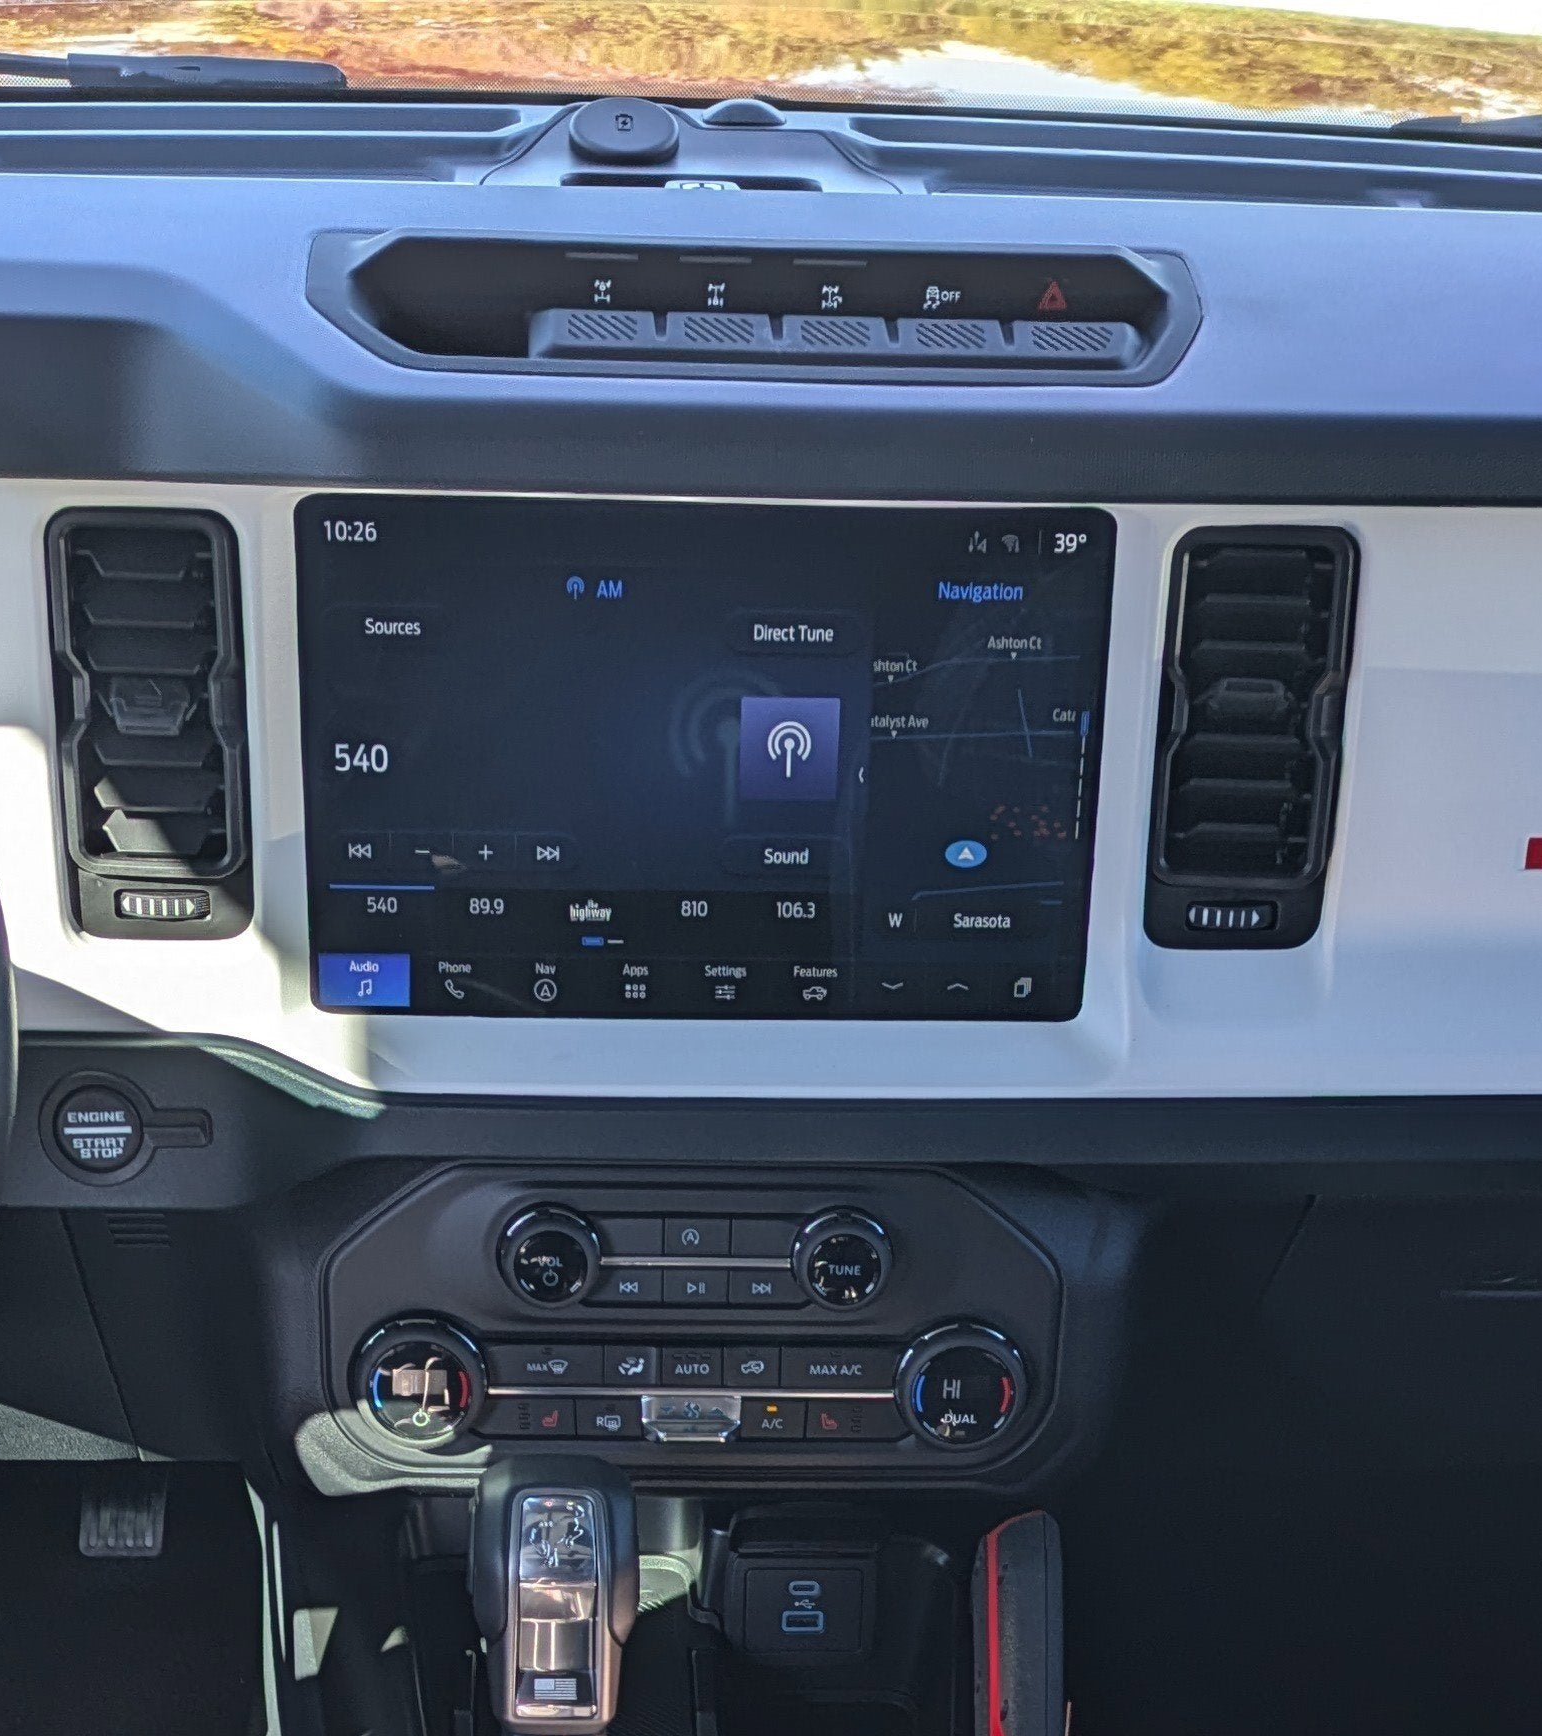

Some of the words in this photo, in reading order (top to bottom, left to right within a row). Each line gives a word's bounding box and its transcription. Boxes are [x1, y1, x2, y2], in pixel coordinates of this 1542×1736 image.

[941, 291, 961, 303] OFF
[323, 520, 377, 542] 10:26
[1054, 533, 1087, 554] 39°
[596, 580, 623, 598] AM
[938, 581, 1024, 603] Navigation
[364, 618, 421, 636] Sources
[754, 624, 795, 642] Direct
[798, 624, 834, 643] Tune
[988, 635, 1027, 650] Ashton
[1029, 636, 1042, 650] Ct
[905, 659, 918, 673] Ct
[908, 715, 929, 729] Ave
[334, 743, 389, 773] 540
[764, 847, 809, 866] Sound
[366, 897, 398, 914] 540
[469, 898, 504, 915] 89.9
[569, 903, 612, 922] highway
[681, 901, 708, 917] 810
[776, 902, 816, 919] 106.3
[888, 913, 903, 928] W
[953, 913, 1011, 929] Sarasota
[349, 961, 380, 974] Audio
[438, 961, 472, 974] Phone
[535, 962, 556, 975] Nav
[623, 963, 649, 978] Apps
[704, 964, 747, 979] Settings
[793, 964, 838, 979] Features
[67, 1111, 125, 1123] ENGINE
[73, 1137, 127, 1149] START
[80, 1147, 124, 1159] STOP
[538, 1255, 563, 1267] VOL
[828, 1265, 861, 1277] TUNE
[527, 1362, 548, 1373] MAX
[675, 1363, 710, 1375] AUTO
[810, 1364, 837, 1375] MAX
[840, 1364, 863, 1376] A/C
[762, 1418, 783, 1430] A/C
[943, 1412, 977, 1425] DUAL
